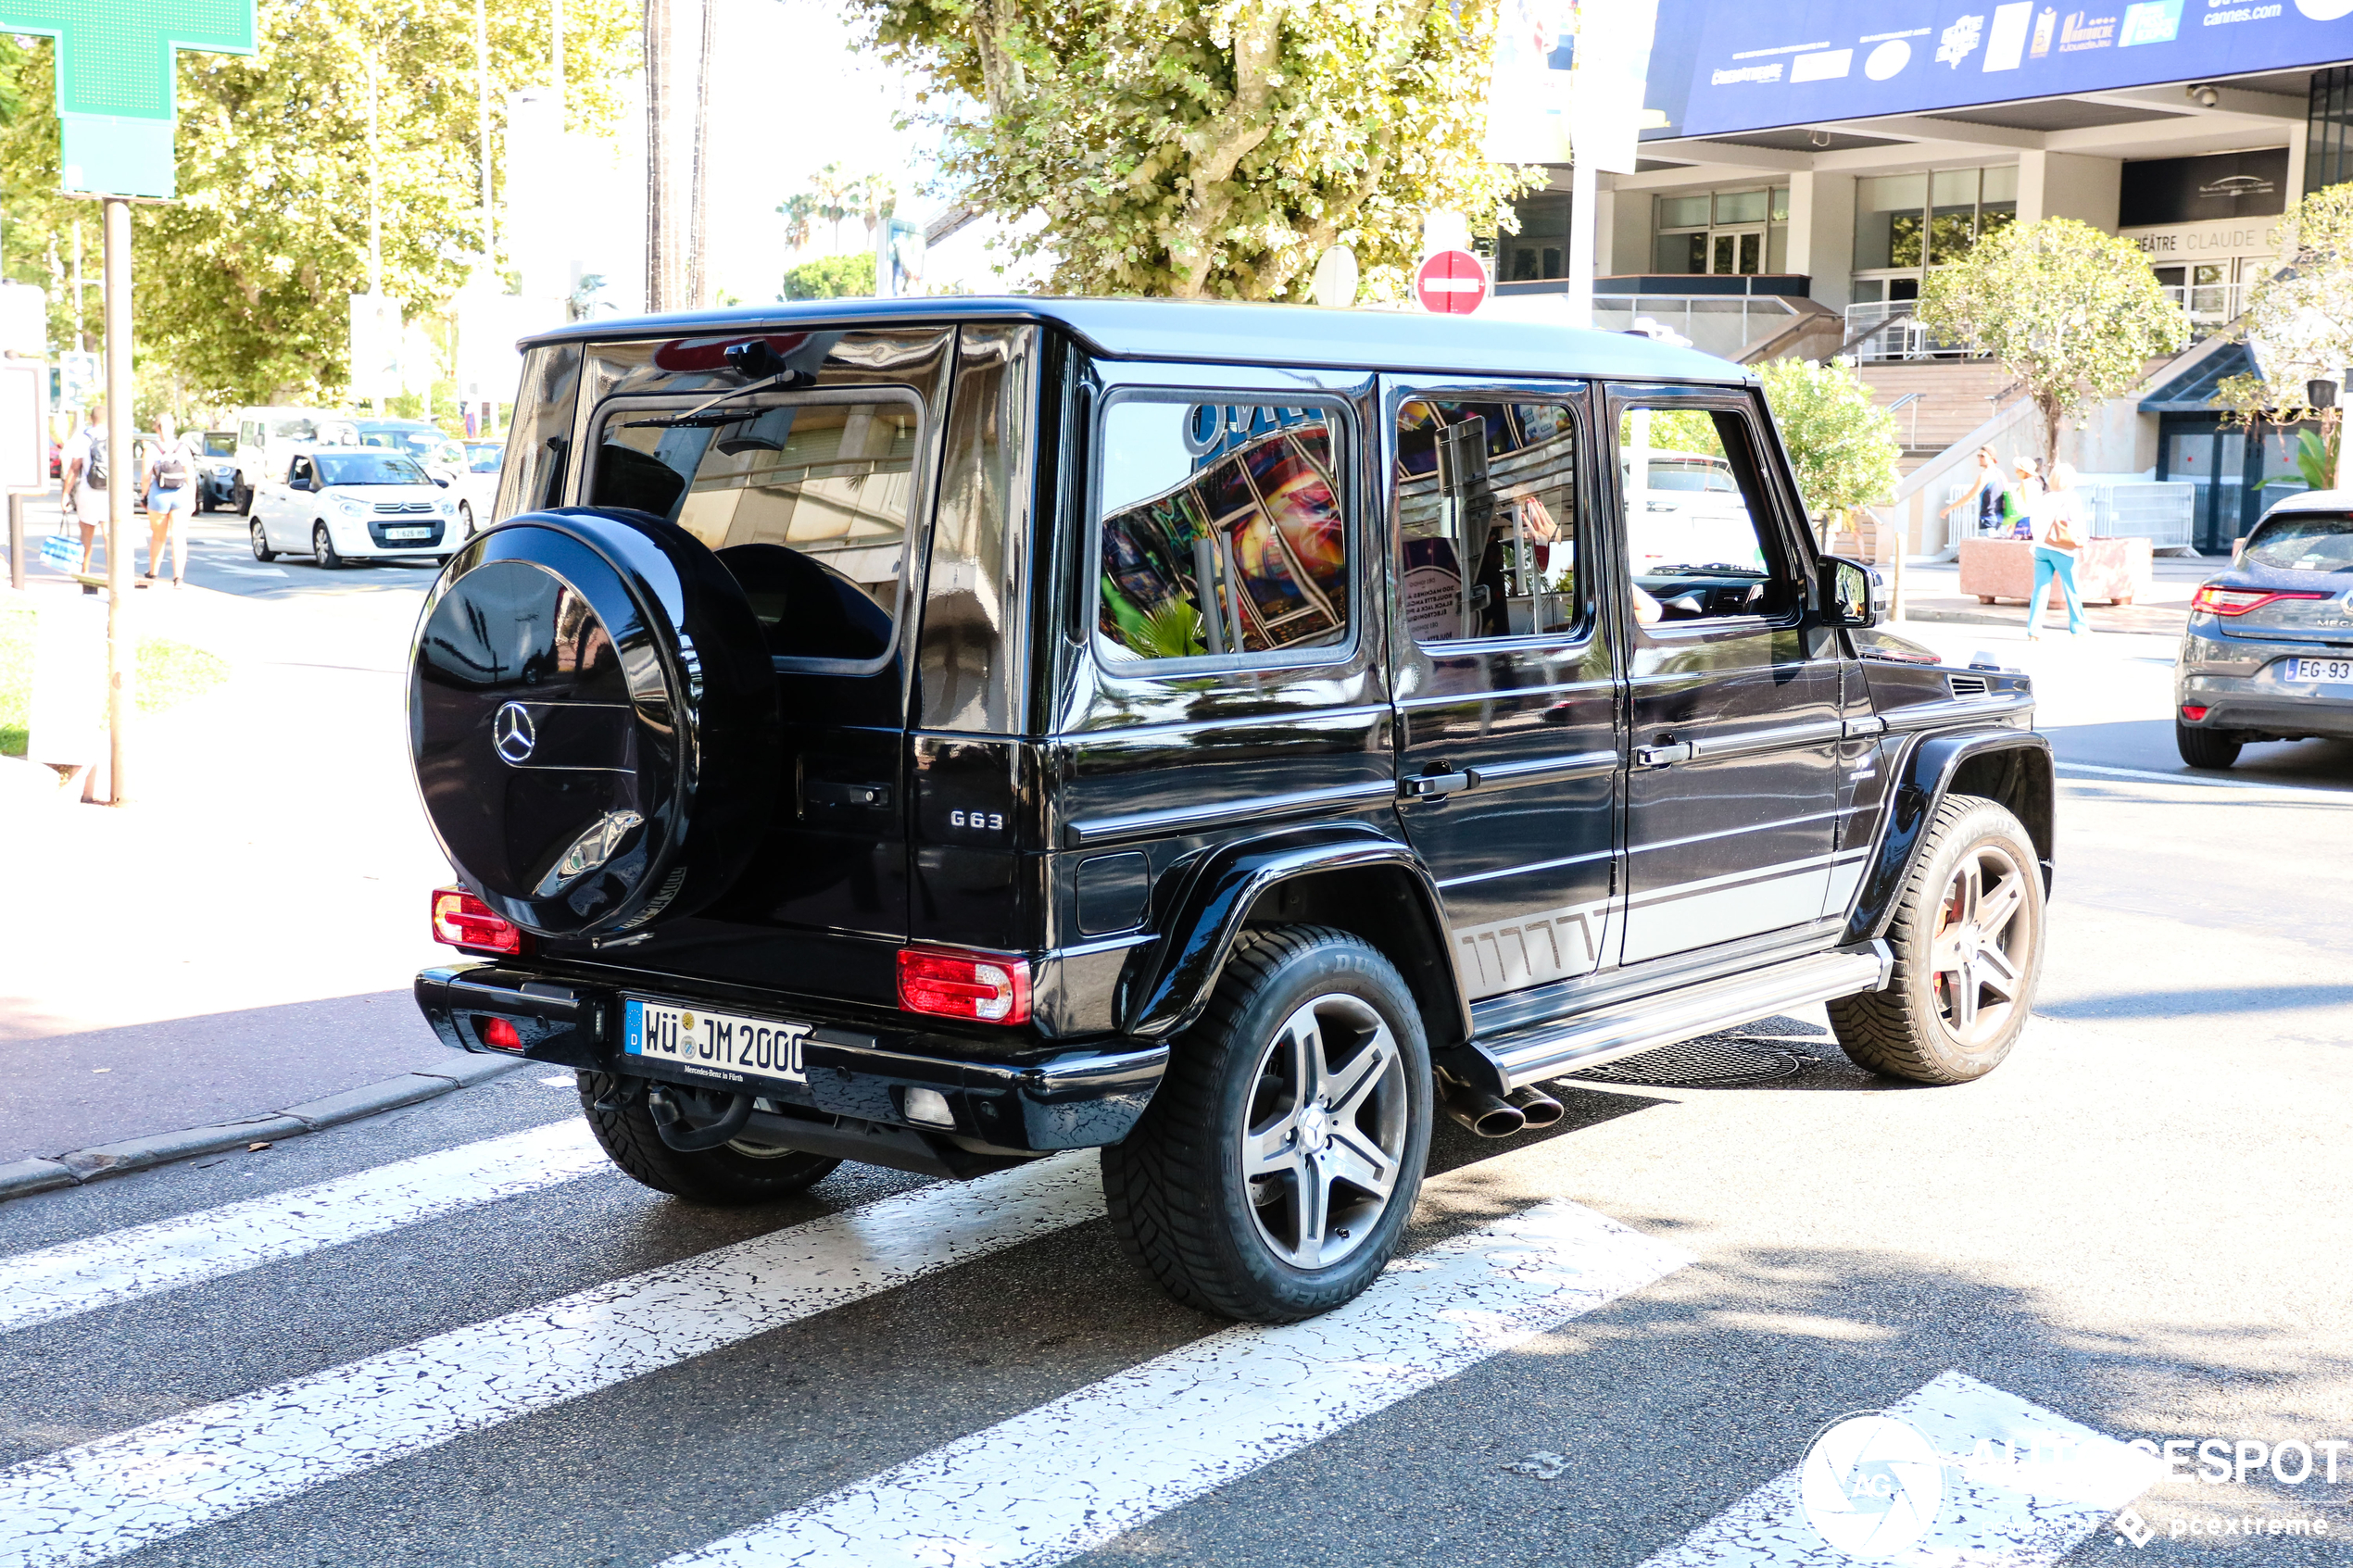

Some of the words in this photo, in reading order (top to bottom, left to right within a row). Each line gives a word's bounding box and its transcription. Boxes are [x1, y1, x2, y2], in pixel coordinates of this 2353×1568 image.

[2203, 4, 2283, 27] cannes.com
[2136, 233, 2177, 253] HÉÂTRE
[2186, 229, 2256, 250] CLAUDE
[2317, 619, 2353, 628] MEG
[2299, 660, 2353, 679] EG-93
[645, 1010, 678, 1054] WÜ
[698, 1019, 733, 1063] JM
[739, 1024, 806, 1074] 2000
[684, 1064, 723, 1079] Mercedes-Benz
[723, 1070, 729, 1080] in
[729, 1072, 744, 1083] Fürth
